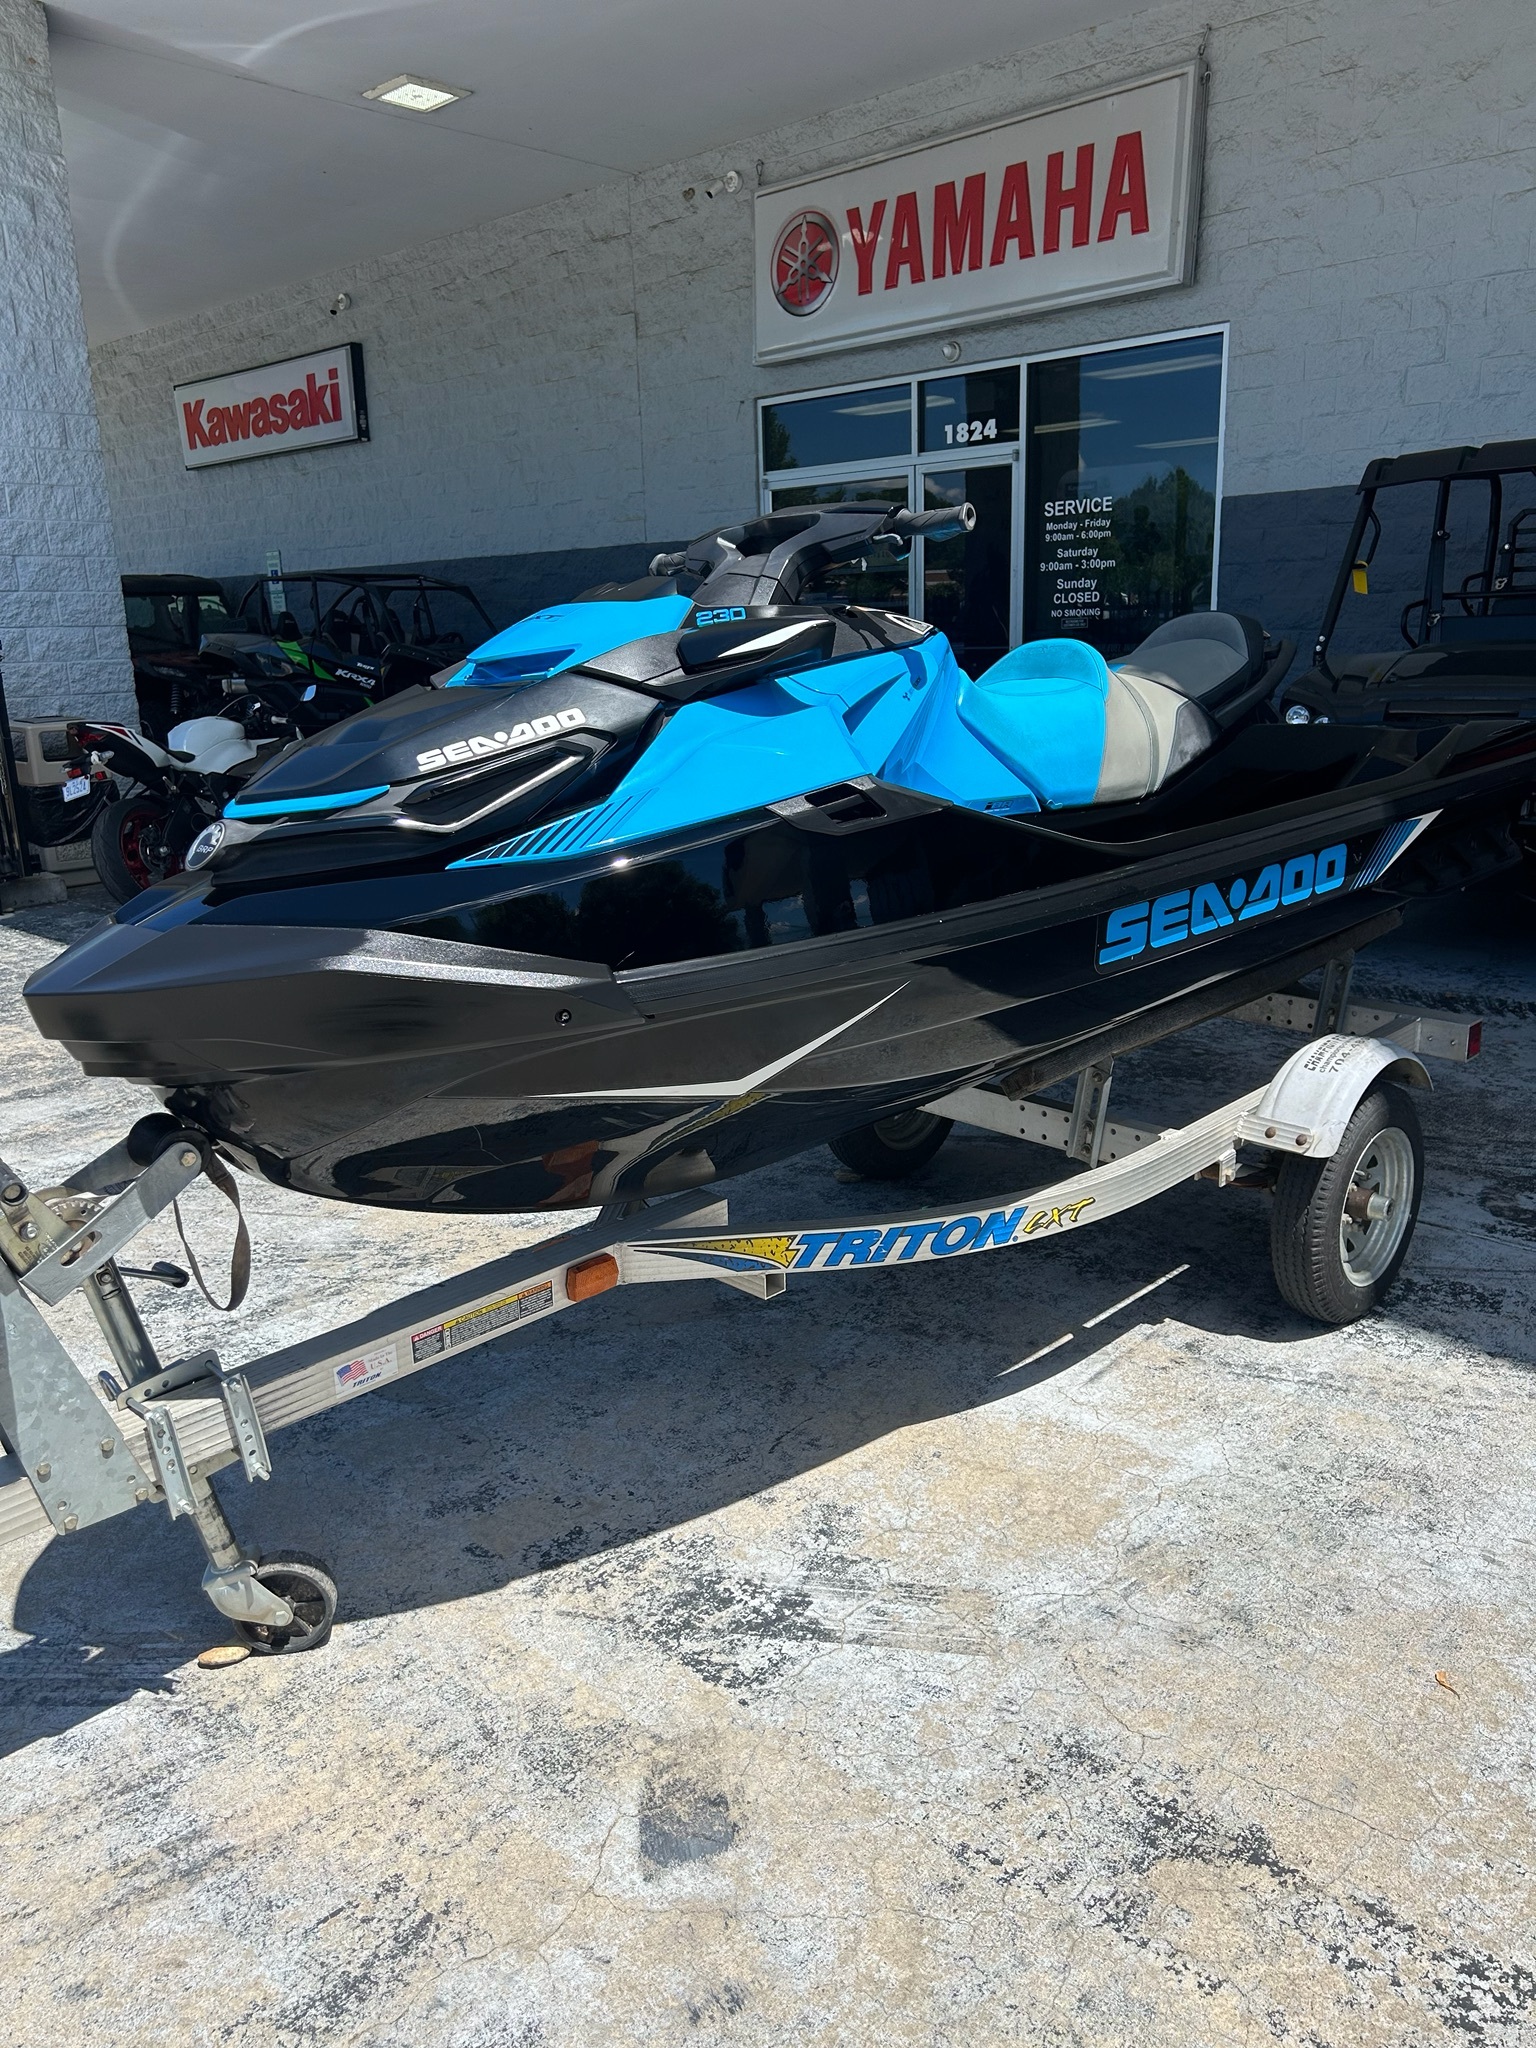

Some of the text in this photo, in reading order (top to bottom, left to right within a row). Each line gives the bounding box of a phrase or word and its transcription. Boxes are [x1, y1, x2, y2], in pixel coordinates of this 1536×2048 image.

[846, 131, 1149, 296] YAMAHA
[183, 367, 342, 450] Kawasaki
[944, 418, 998, 444] 1824
[1044, 496, 1113, 517] SERVICE
[1046, 521, 1078, 531] Monday
[1085, 518, 1111, 528] Friday
[1045, 532, 1074, 542] 9:00am
[1081, 530, 1112, 540] 6:00pm
[1057, 547, 1098, 558] Saturday
[1040, 561, 1072, 572] 9:00am
[1081, 559, 1116, 570] 3:00pm
[1057, 578, 1097, 590] Sunday
[1054, 591, 1100, 604] CLOSED
[695, 607, 747, 627] 230
[1051, 608, 1100, 618] NO SMOKING
[335, 668, 376, 686] KRX4
[790, 1206, 1029, 1268] TRITON
[352, 1372, 382, 1388] TRITON
